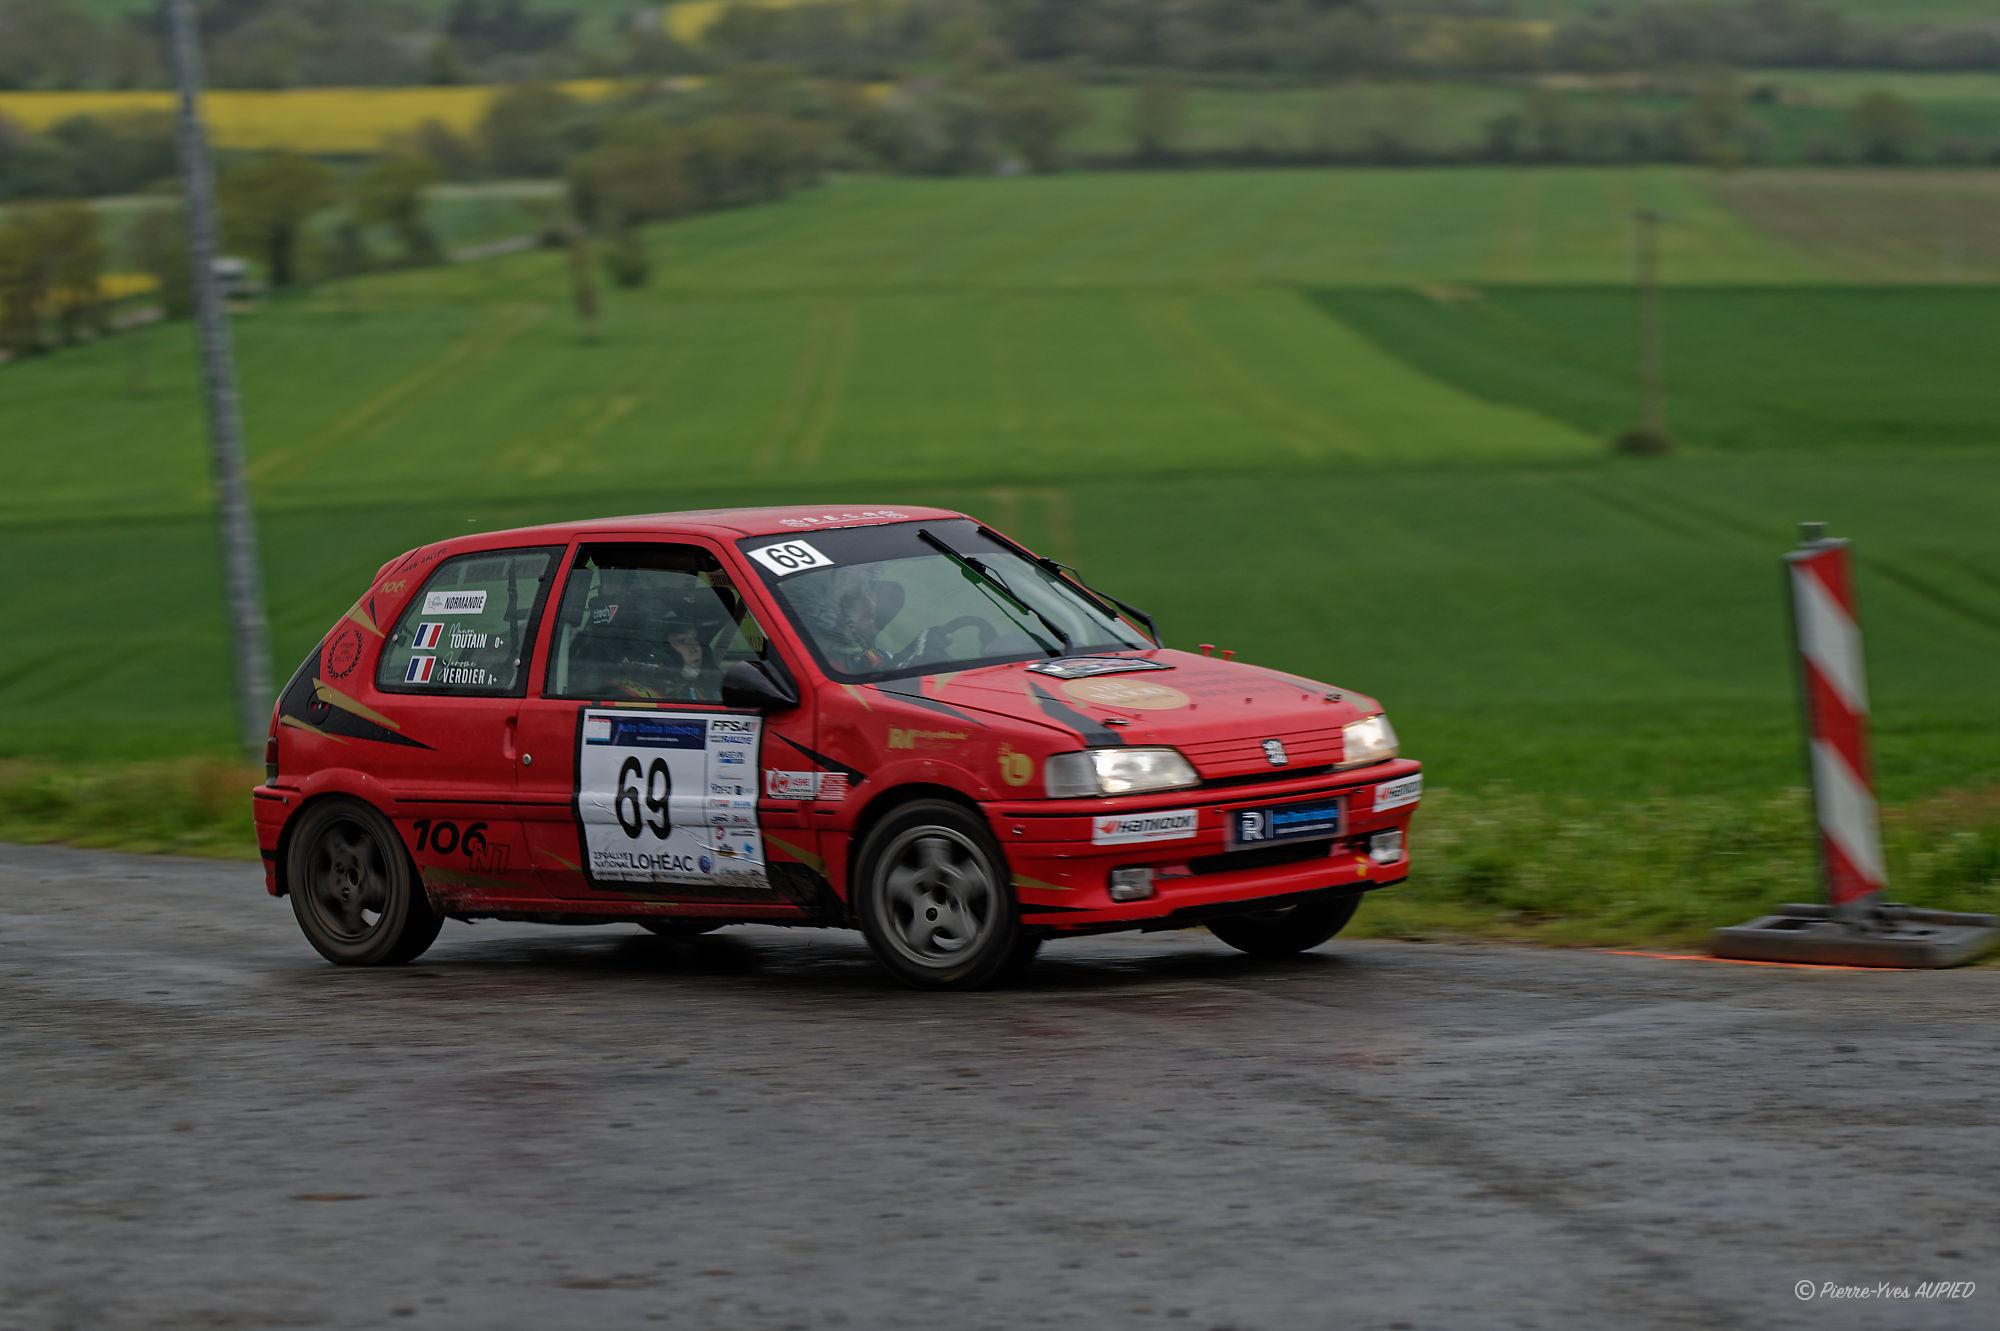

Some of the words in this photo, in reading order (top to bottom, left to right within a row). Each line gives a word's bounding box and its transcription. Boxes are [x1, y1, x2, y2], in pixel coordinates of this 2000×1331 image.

[765, 544, 816, 569] 69
[380, 580, 407, 593] 106
[444, 596, 485, 610] NORMANDIE
[450, 633, 487, 649] TOUTAIN
[442, 668, 485, 685] VERDIER
[487, 673, 497, 686] A+
[711, 720, 751, 733] FFSA
[615, 755, 672, 840] 69
[412, 819, 488, 859] 106
[469, 840, 511, 875] N1
[593, 860, 630, 869] NATIONAL
[628, 851, 694, 872] LOHÉAC
